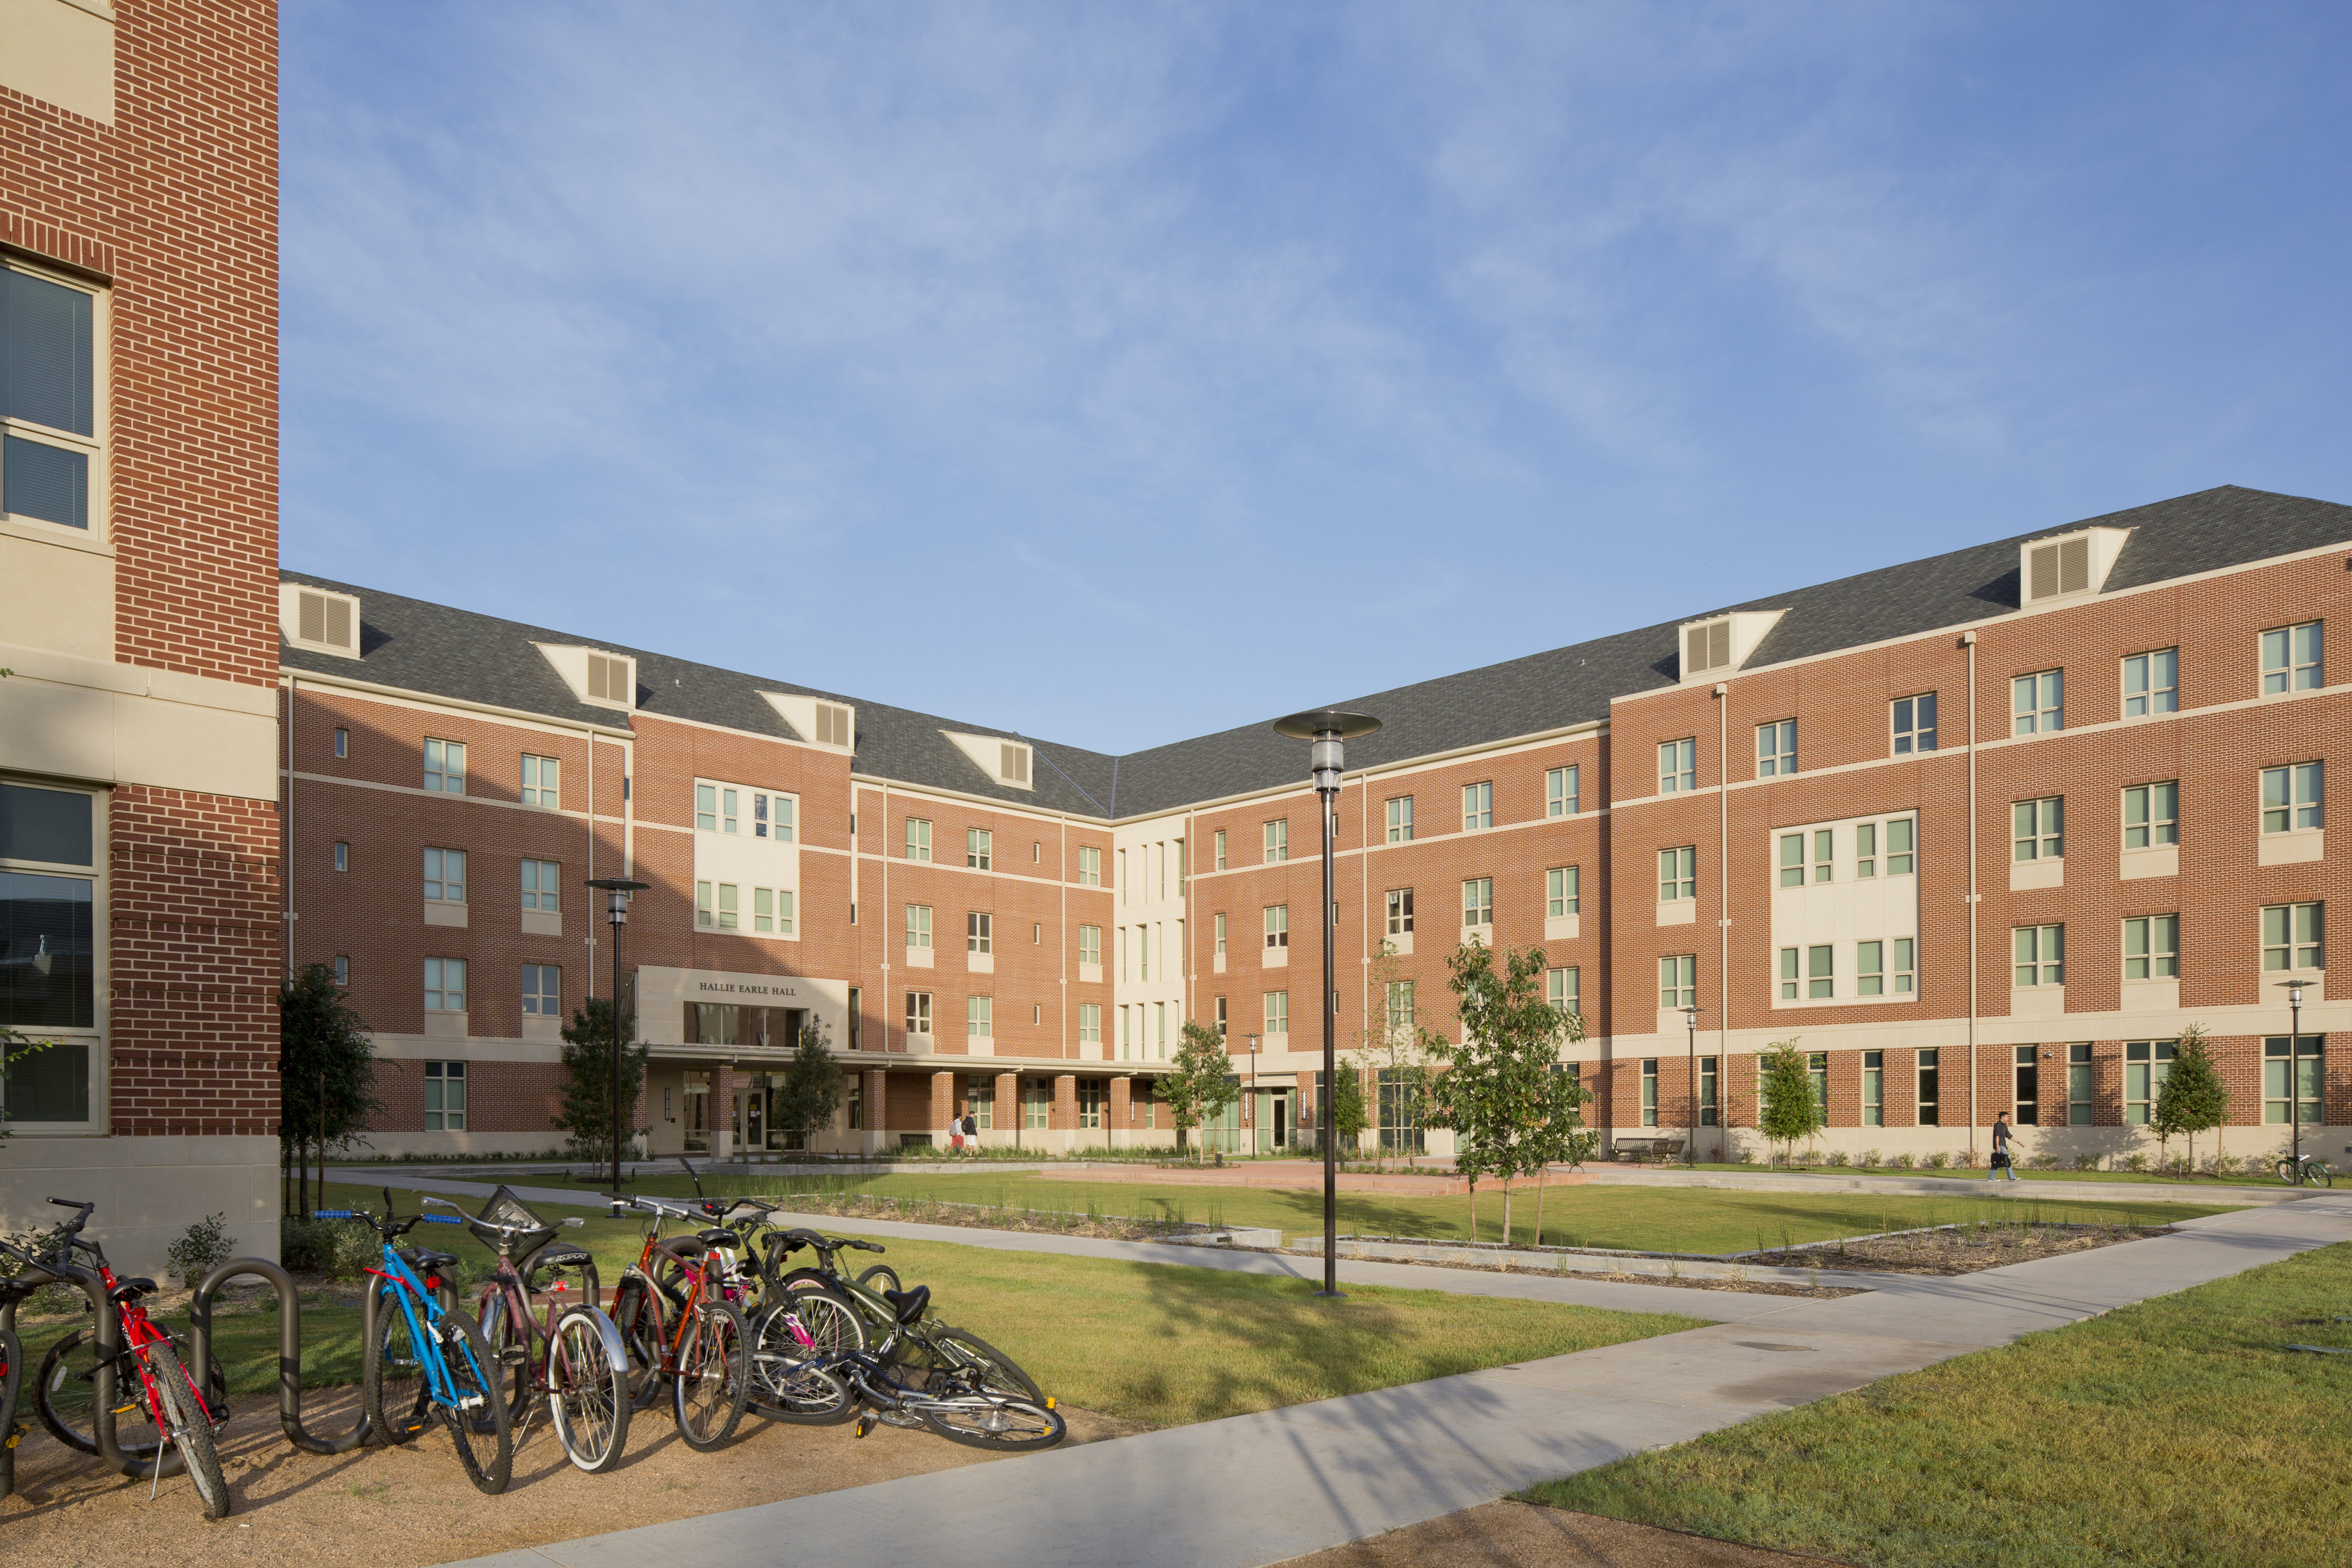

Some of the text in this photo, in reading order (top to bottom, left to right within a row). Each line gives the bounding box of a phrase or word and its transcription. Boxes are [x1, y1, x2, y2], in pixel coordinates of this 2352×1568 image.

[699, 982, 796, 996] HALLIE EARLE HALL
[555, 1252, 587, 1262] HUFFY
